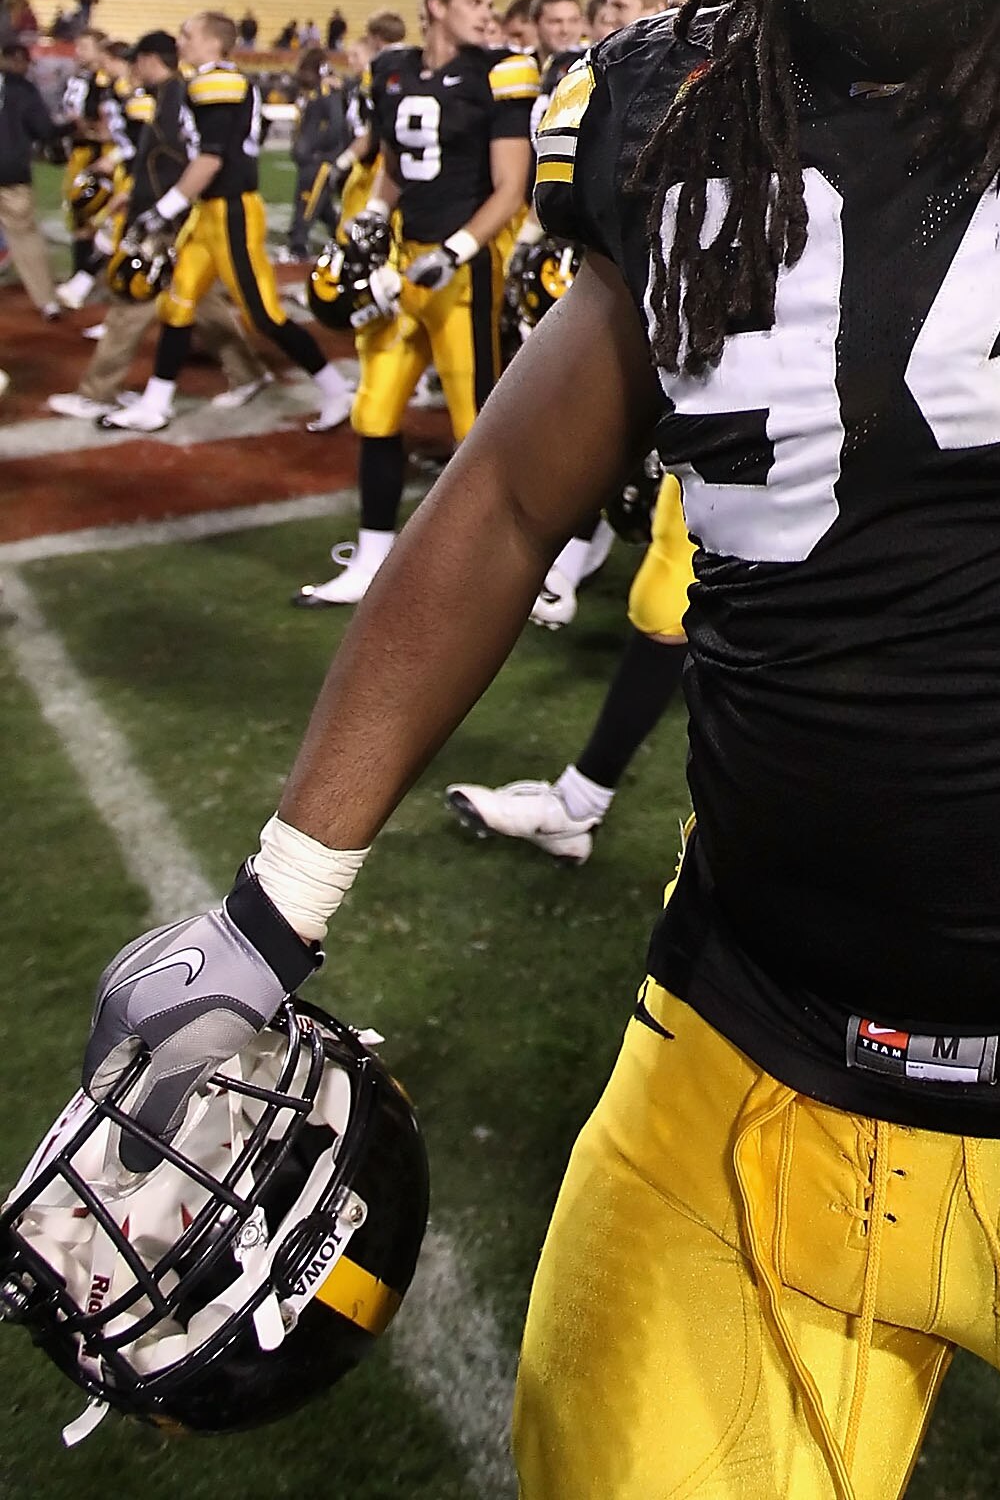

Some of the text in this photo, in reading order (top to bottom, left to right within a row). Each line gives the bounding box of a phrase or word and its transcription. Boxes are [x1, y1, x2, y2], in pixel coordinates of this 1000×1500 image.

[395, 96, 441, 181] 9
[862, 1038, 901, 1058] TEAM
[932, 1036, 961, 1060] M
[294, 1232, 343, 1296] IOWA
